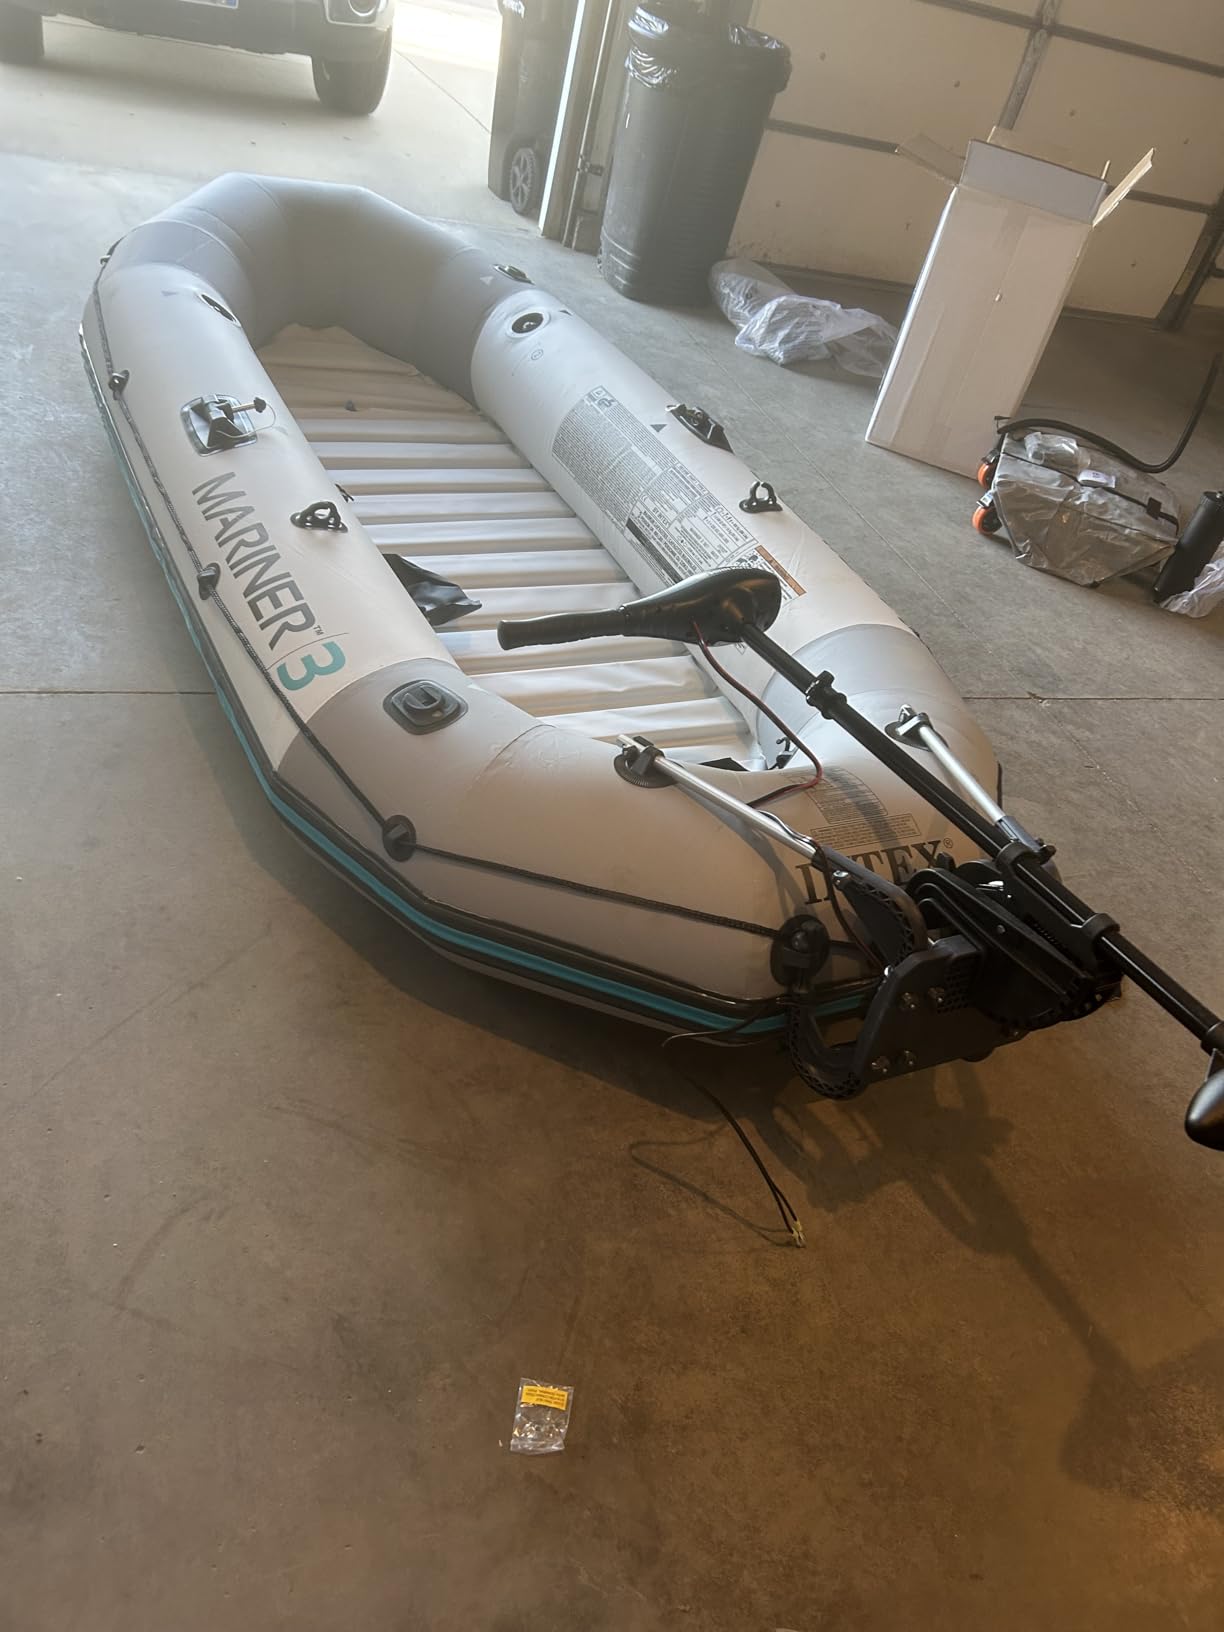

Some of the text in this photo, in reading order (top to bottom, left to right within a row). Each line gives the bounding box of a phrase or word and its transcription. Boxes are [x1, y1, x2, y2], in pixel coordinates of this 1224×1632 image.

[192, 472, 316, 650] MARINER
[276, 641, 346, 691] 3
[796, 840, 942, 905] ITEX
